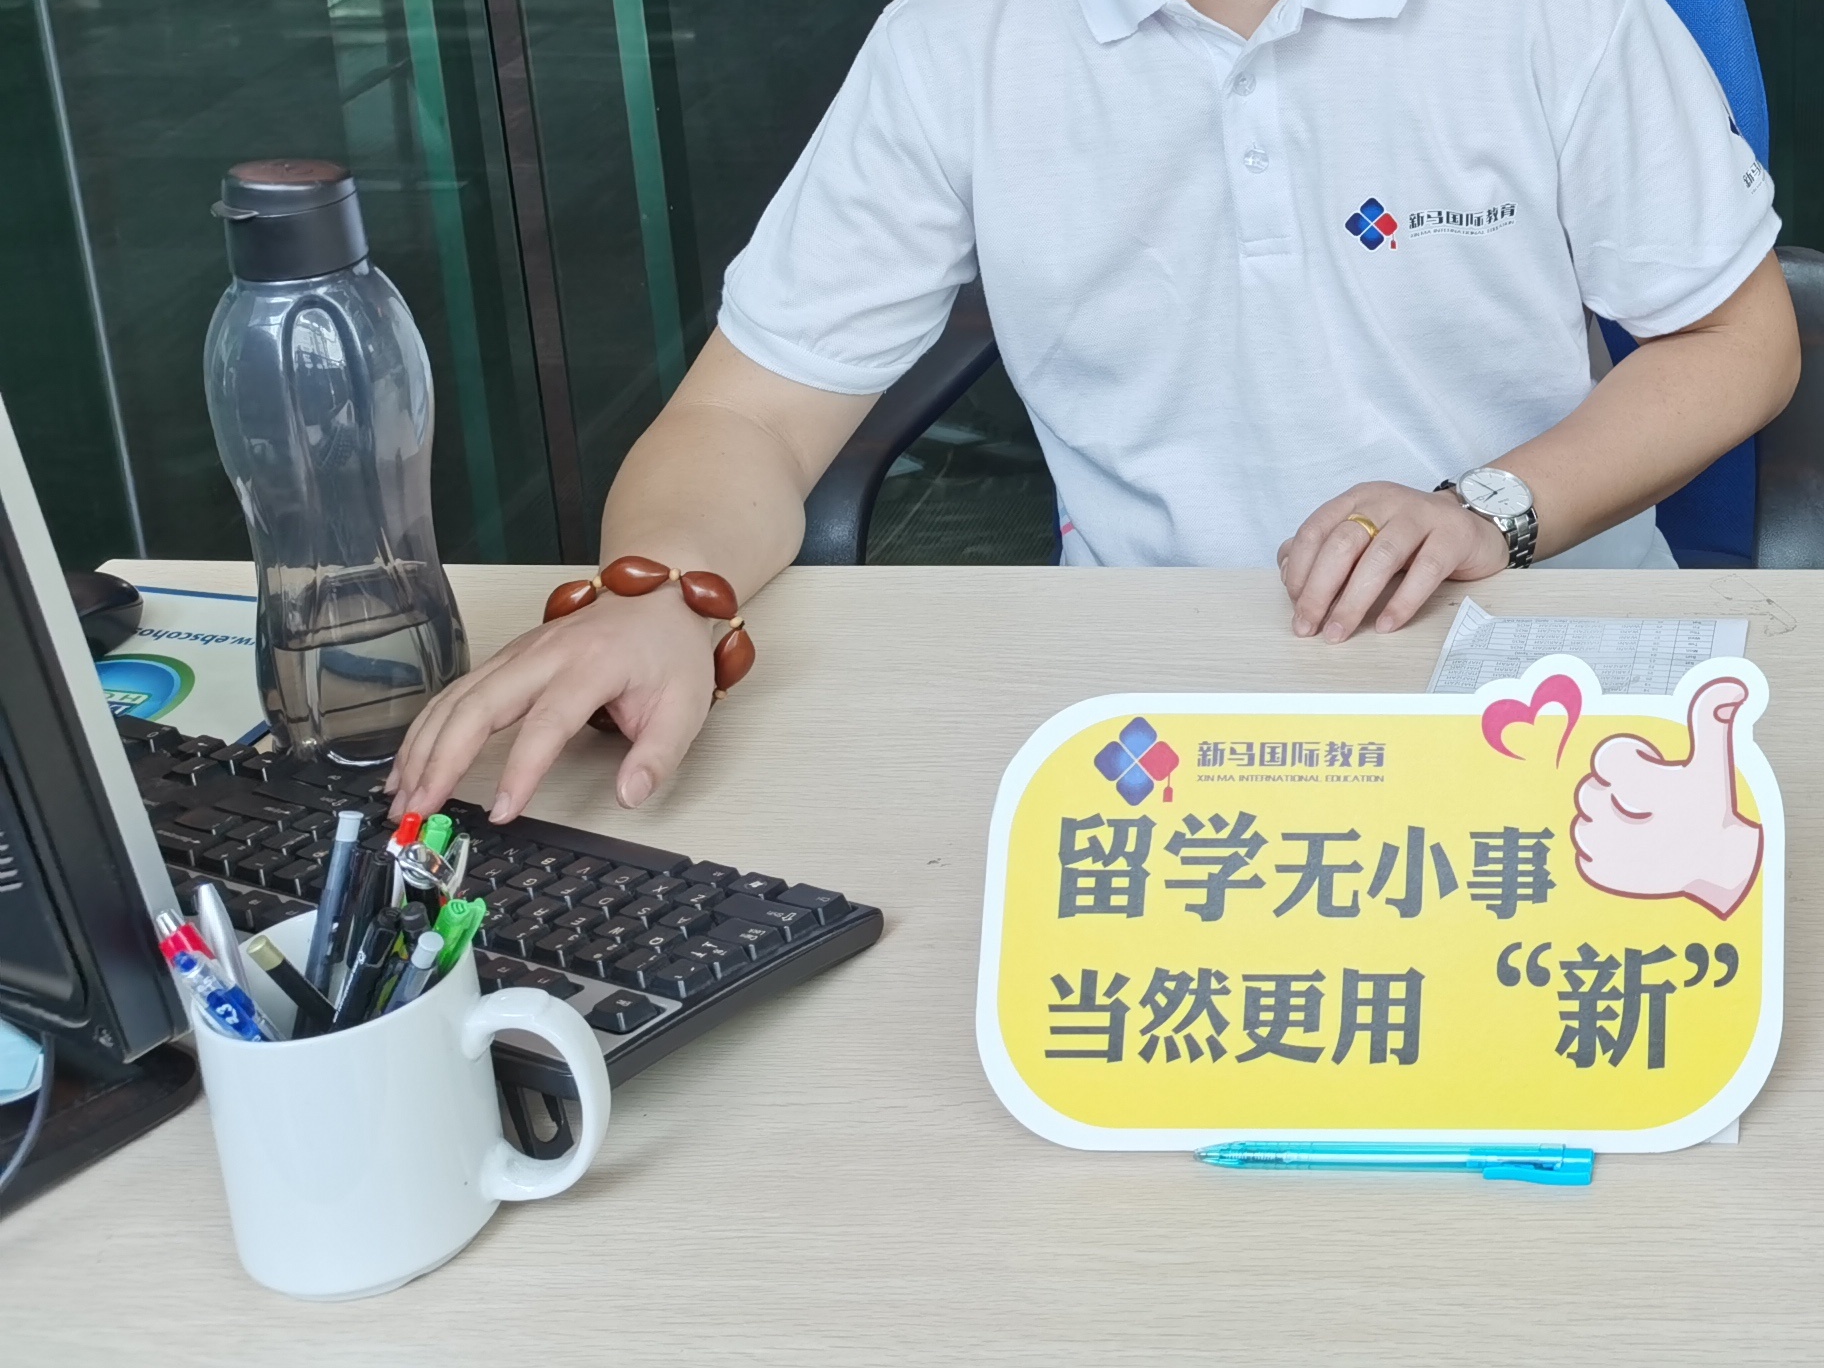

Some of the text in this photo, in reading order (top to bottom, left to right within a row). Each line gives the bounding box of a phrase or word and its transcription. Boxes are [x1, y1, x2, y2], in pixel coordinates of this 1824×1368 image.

[1409, 203, 1517, 230] 新马国际教育
[1197, 740, 1387, 768] 新马国际教育
[1197, 774, 1385, 783] XIN MA INTERNATIONAL EDUCATION
[1056, 810, 1558, 923] 留学无小事
[1043, 939, 1741, 1071] 当然更用 “新”
